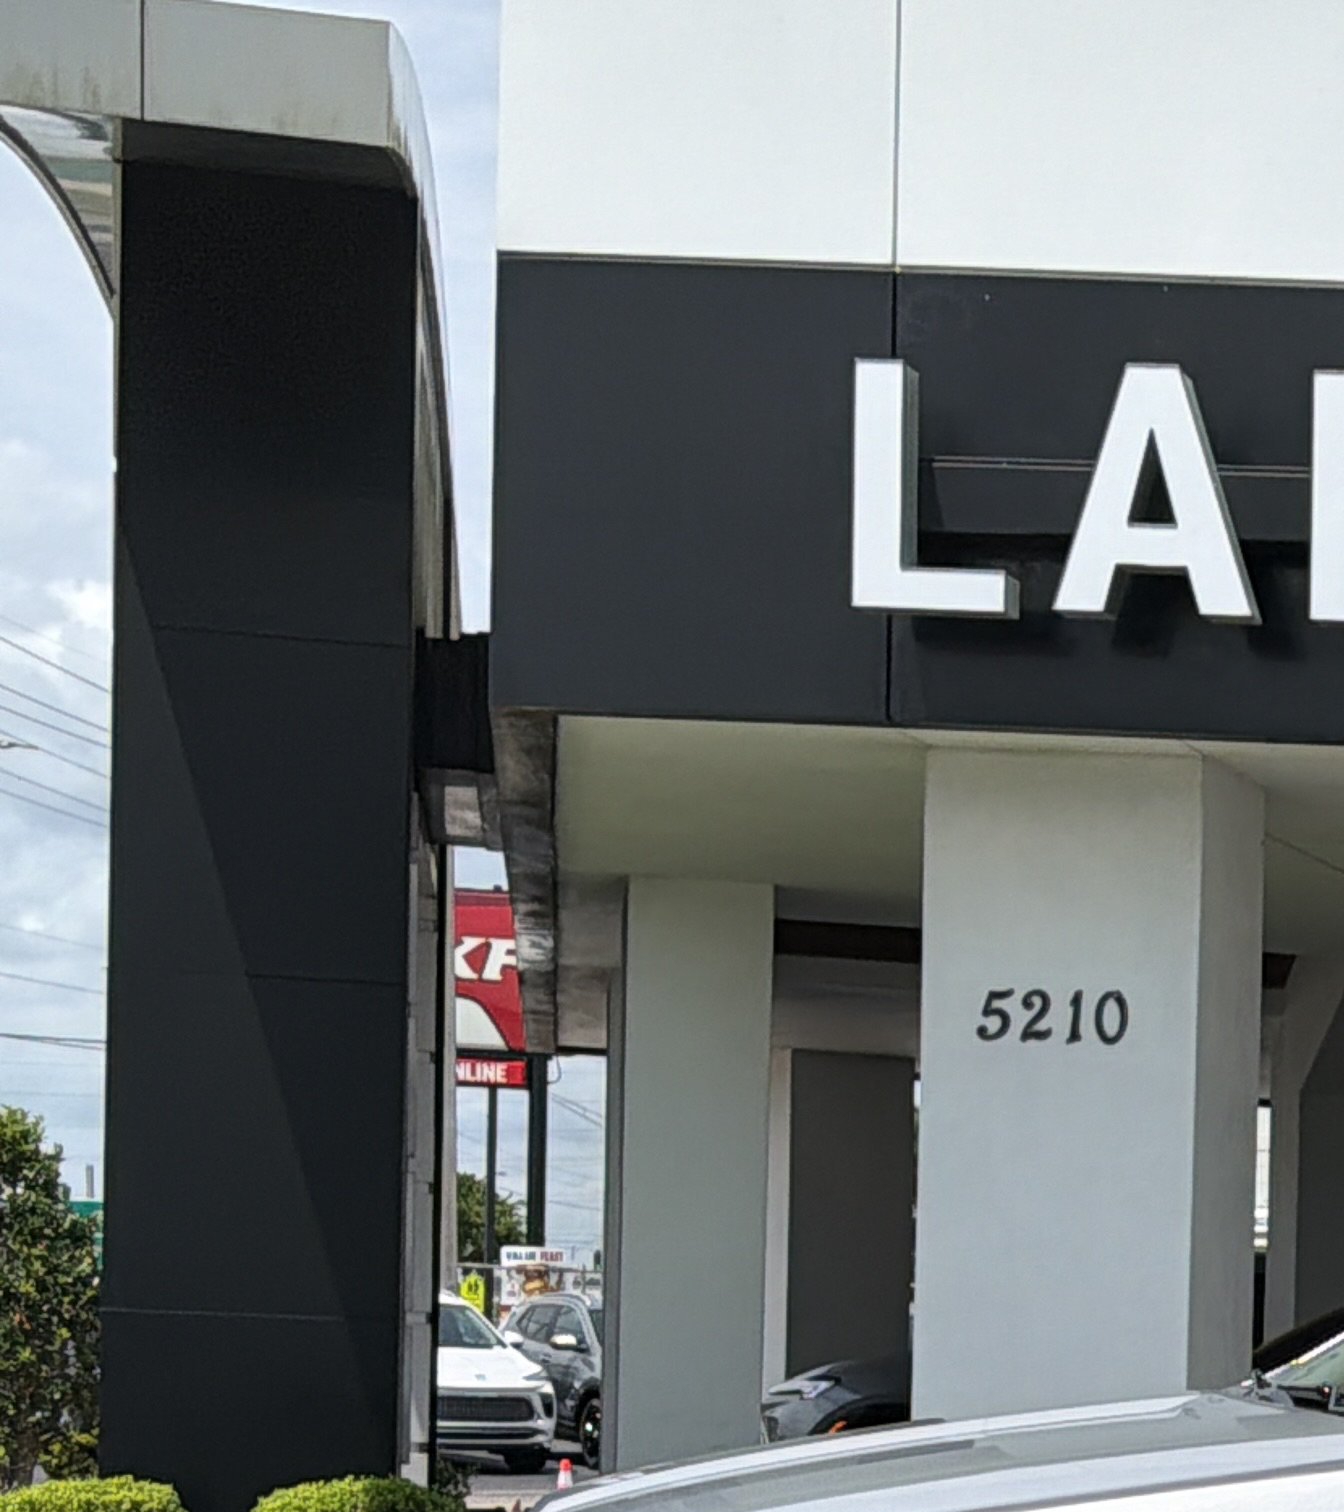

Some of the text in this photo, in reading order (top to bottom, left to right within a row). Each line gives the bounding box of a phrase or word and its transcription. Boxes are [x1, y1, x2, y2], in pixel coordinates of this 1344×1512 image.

[455, 936, 517, 980] KF
[976, 988, 1128, 1045] 5210
[456, 1061, 508, 1083] NLINE
